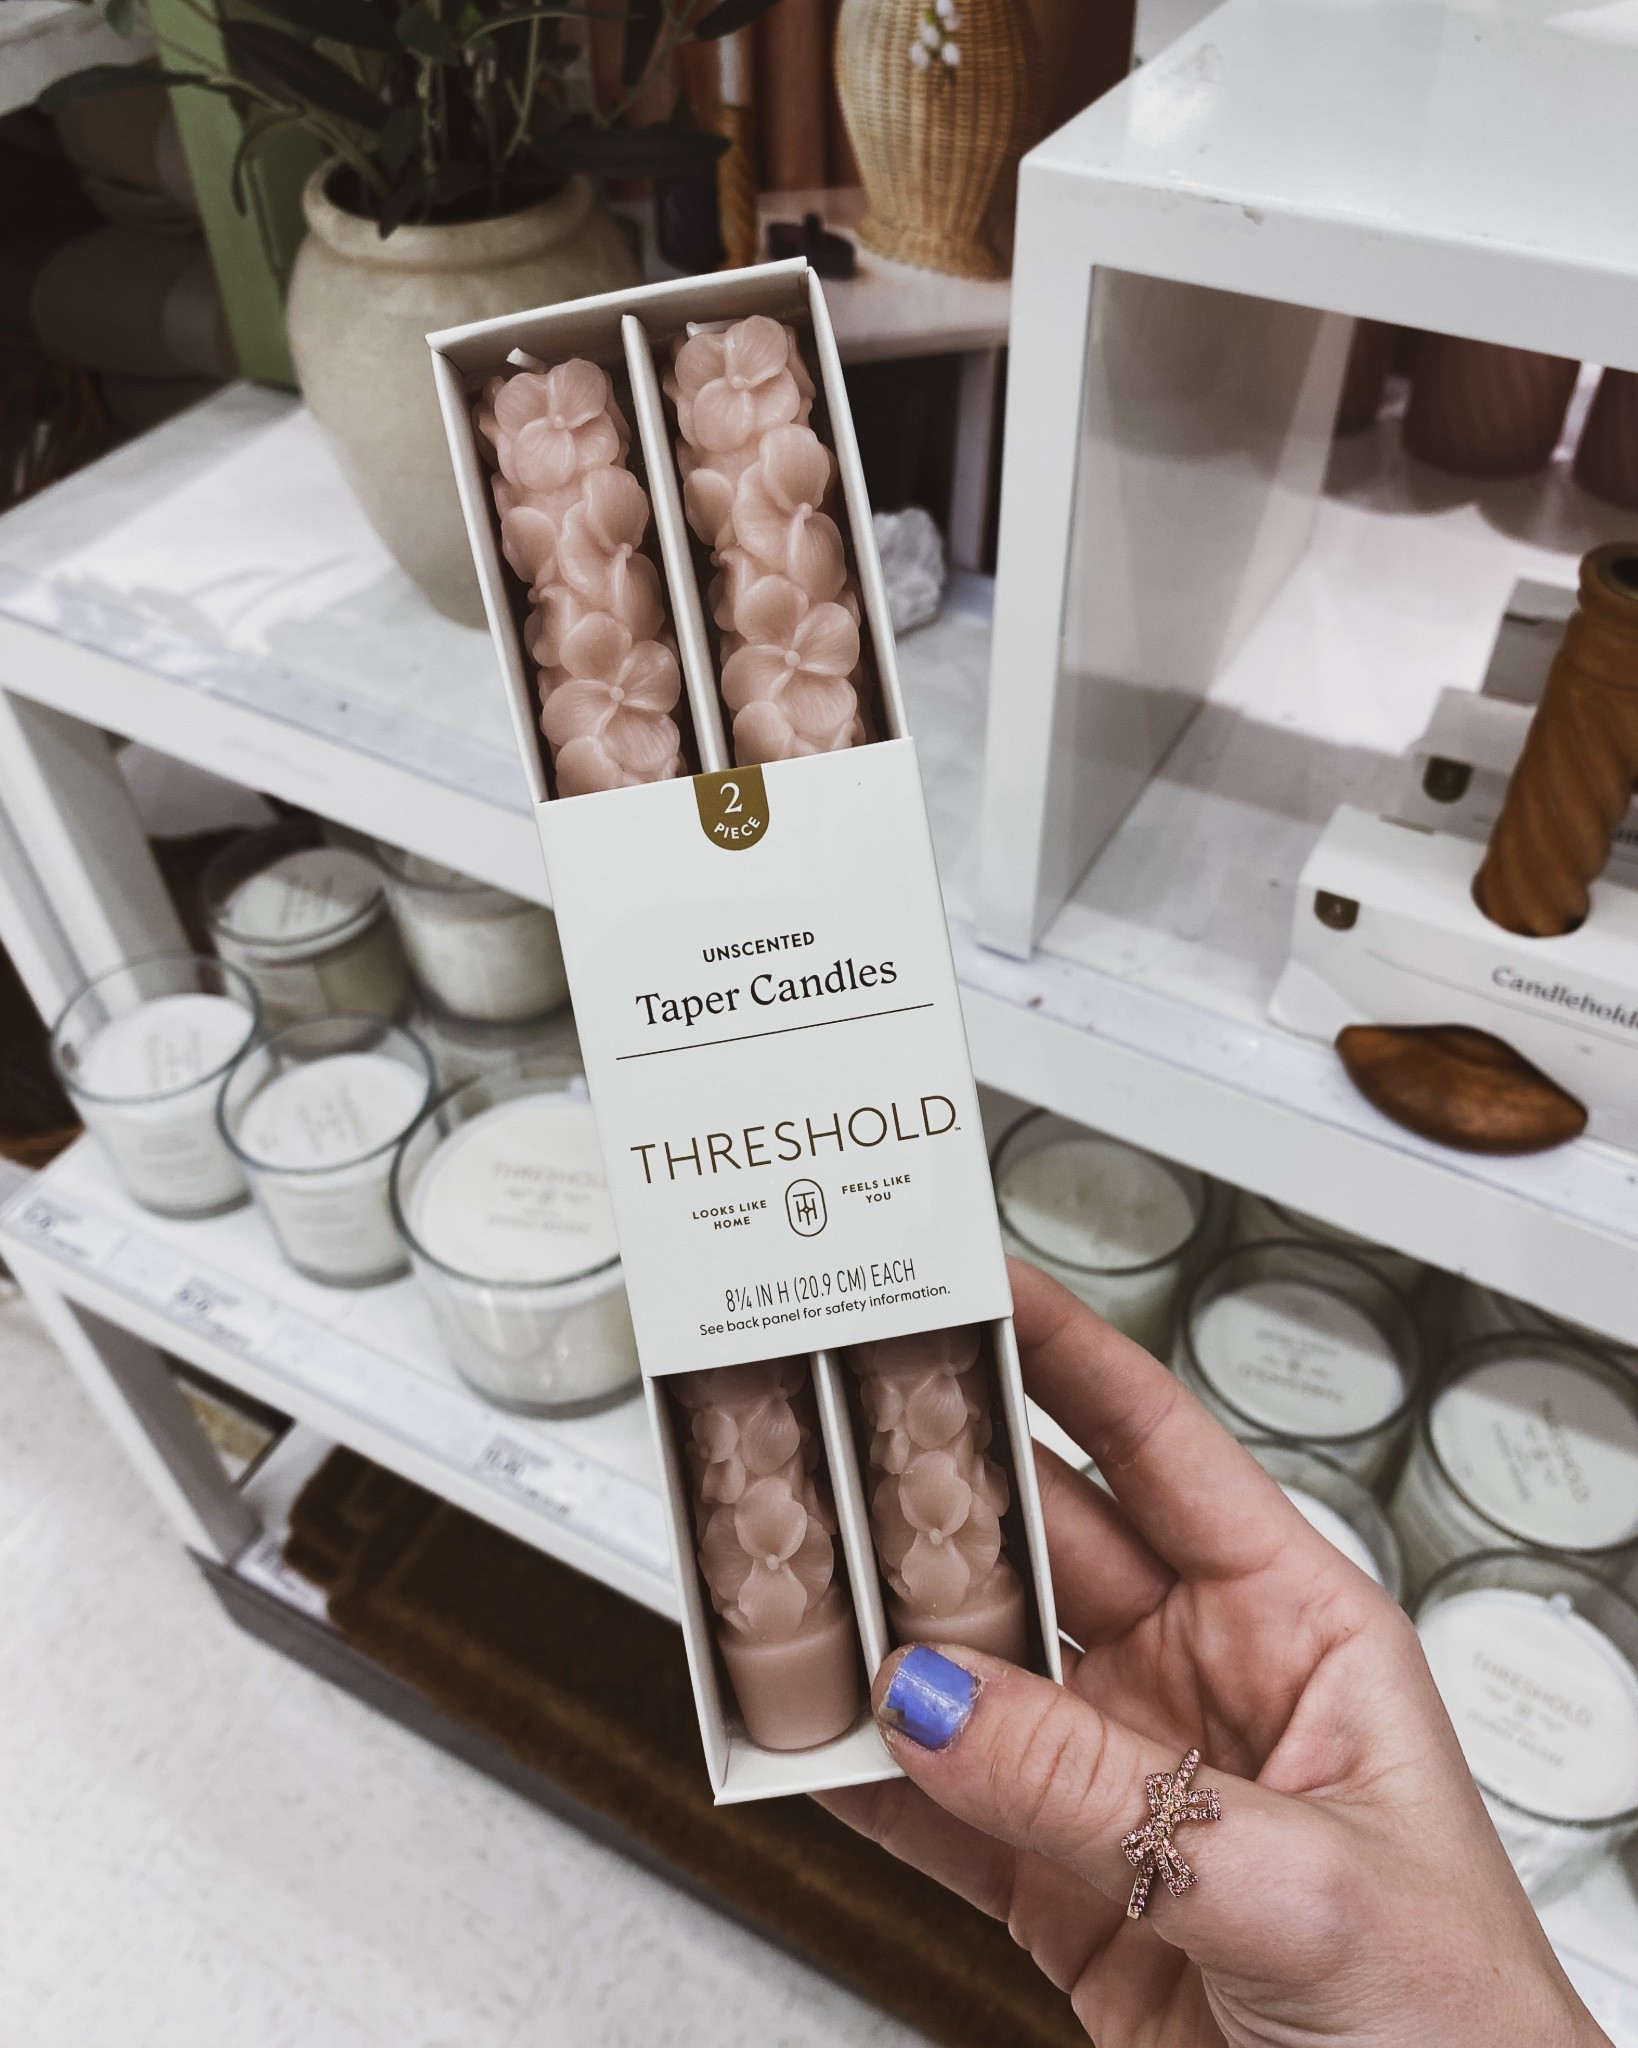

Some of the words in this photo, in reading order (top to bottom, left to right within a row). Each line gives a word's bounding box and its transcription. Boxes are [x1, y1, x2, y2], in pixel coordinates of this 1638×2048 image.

[720, 782, 743, 814] 2
[713, 816, 761, 840] PIECE
[702, 931, 815, 963] UNSCENTED
[635, 988, 741, 1027] Taper
[749, 958, 899, 1006] Candles
[1491, 965, 1638, 1030] Candlehold
[630, 1095, 957, 1184] THRESHOLD
[841, 1178, 880, 1195] FEELS
[883, 1174, 912, 1188] LIKE
[865, 1191, 892, 1204] YOU
[692, 1205, 735, 1220] LOOKS
[739, 1199, 768, 1213] LIKE
[713, 1215, 751, 1230] HOME
[755, 1283, 774, 1308] IN
[776, 1280, 790, 1304] H
[793, 1272, 831, 1304] (20.9
[836, 1265, 867, 1294] CM)
[870, 1257, 916, 1288] EACH
[699, 1324, 725, 1336] See
[726, 1315, 760, 1332] back
[761, 1308, 801, 1330] panel
[802, 1307, 823, 1320] for
[825, 1299, 867, 1317] safety
[869, 1284, 951, 1308] information.
